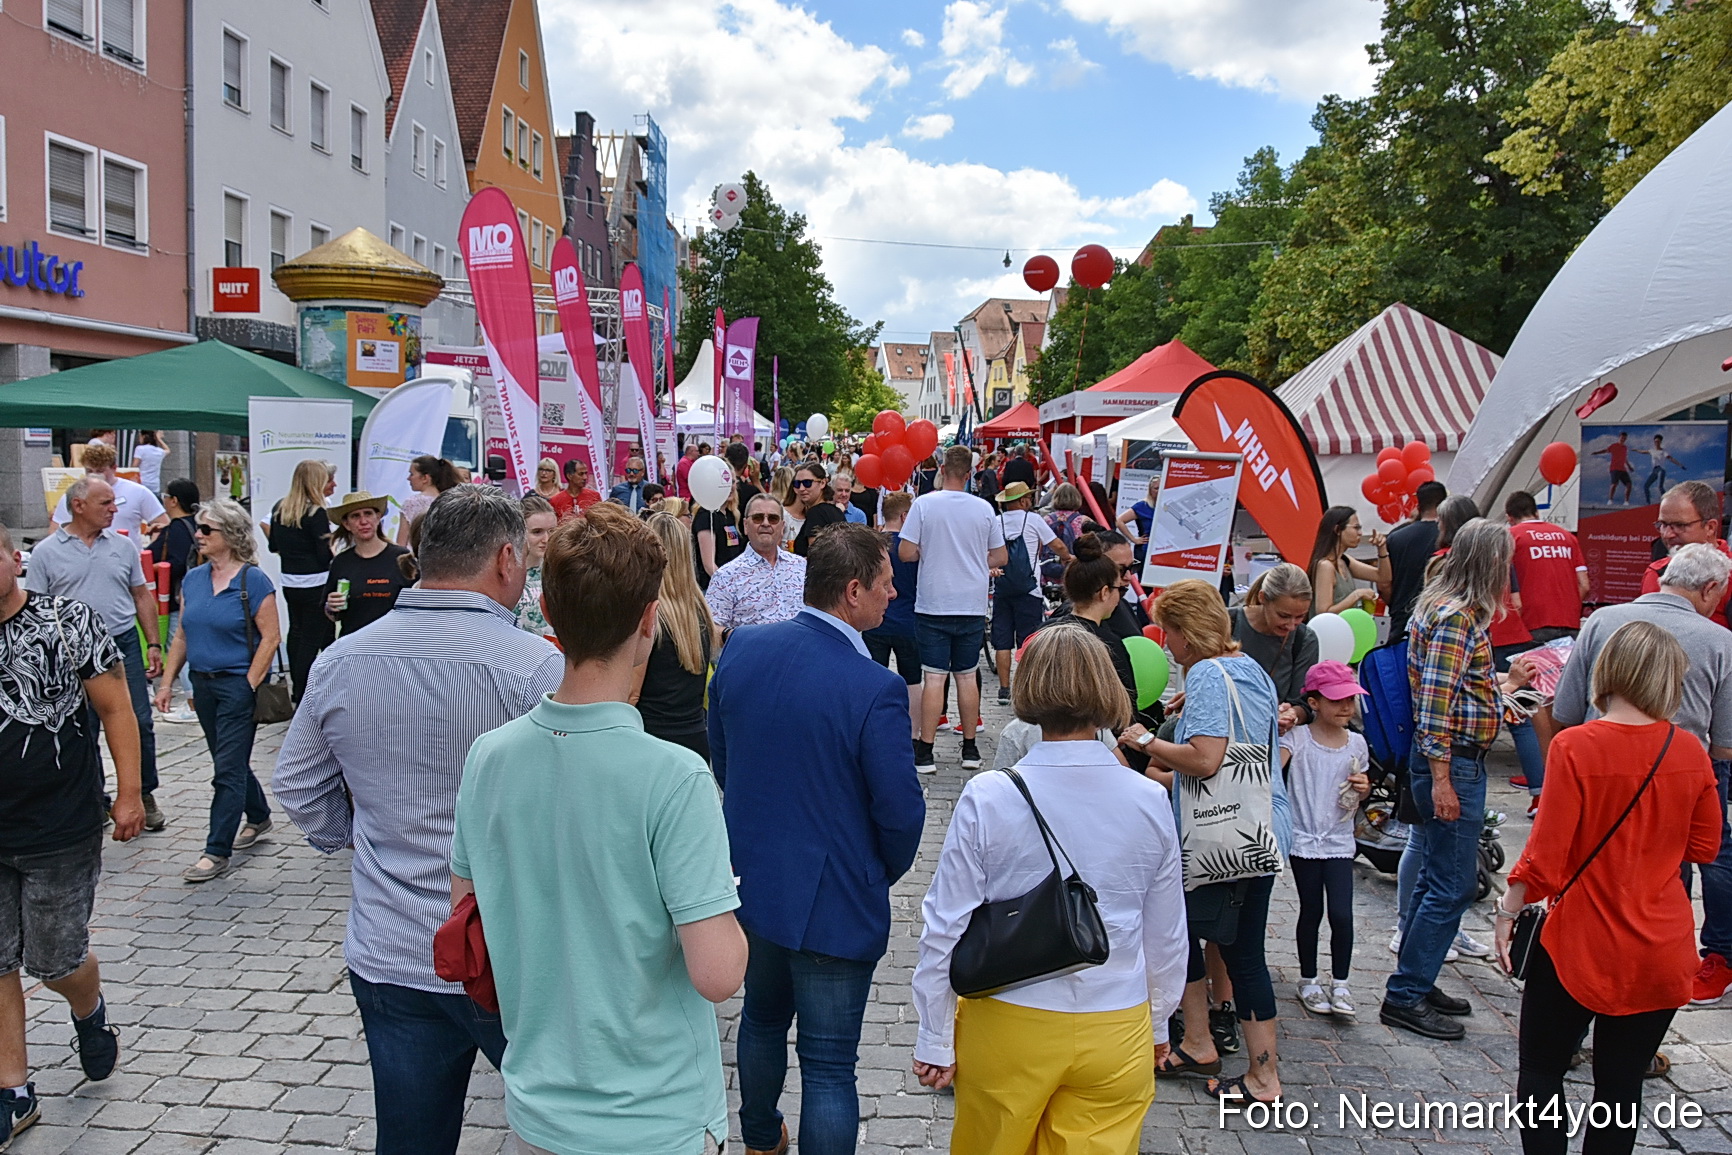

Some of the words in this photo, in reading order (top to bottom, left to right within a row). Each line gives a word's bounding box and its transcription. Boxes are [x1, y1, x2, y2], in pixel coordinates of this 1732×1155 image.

[218, 282, 250, 294] WITT
[453, 355, 480, 365] JETZT
[1102, 399, 1159, 407] HAMMERBACHER
[1526, 530, 1566, 541] Team
[1588, 533, 1628, 543] Ausbildung
[1629, 534, 1641, 542] bei
[1180, 552, 1218, 562] #virtualreality
[1529, 545, 1572, 560] DEHN
